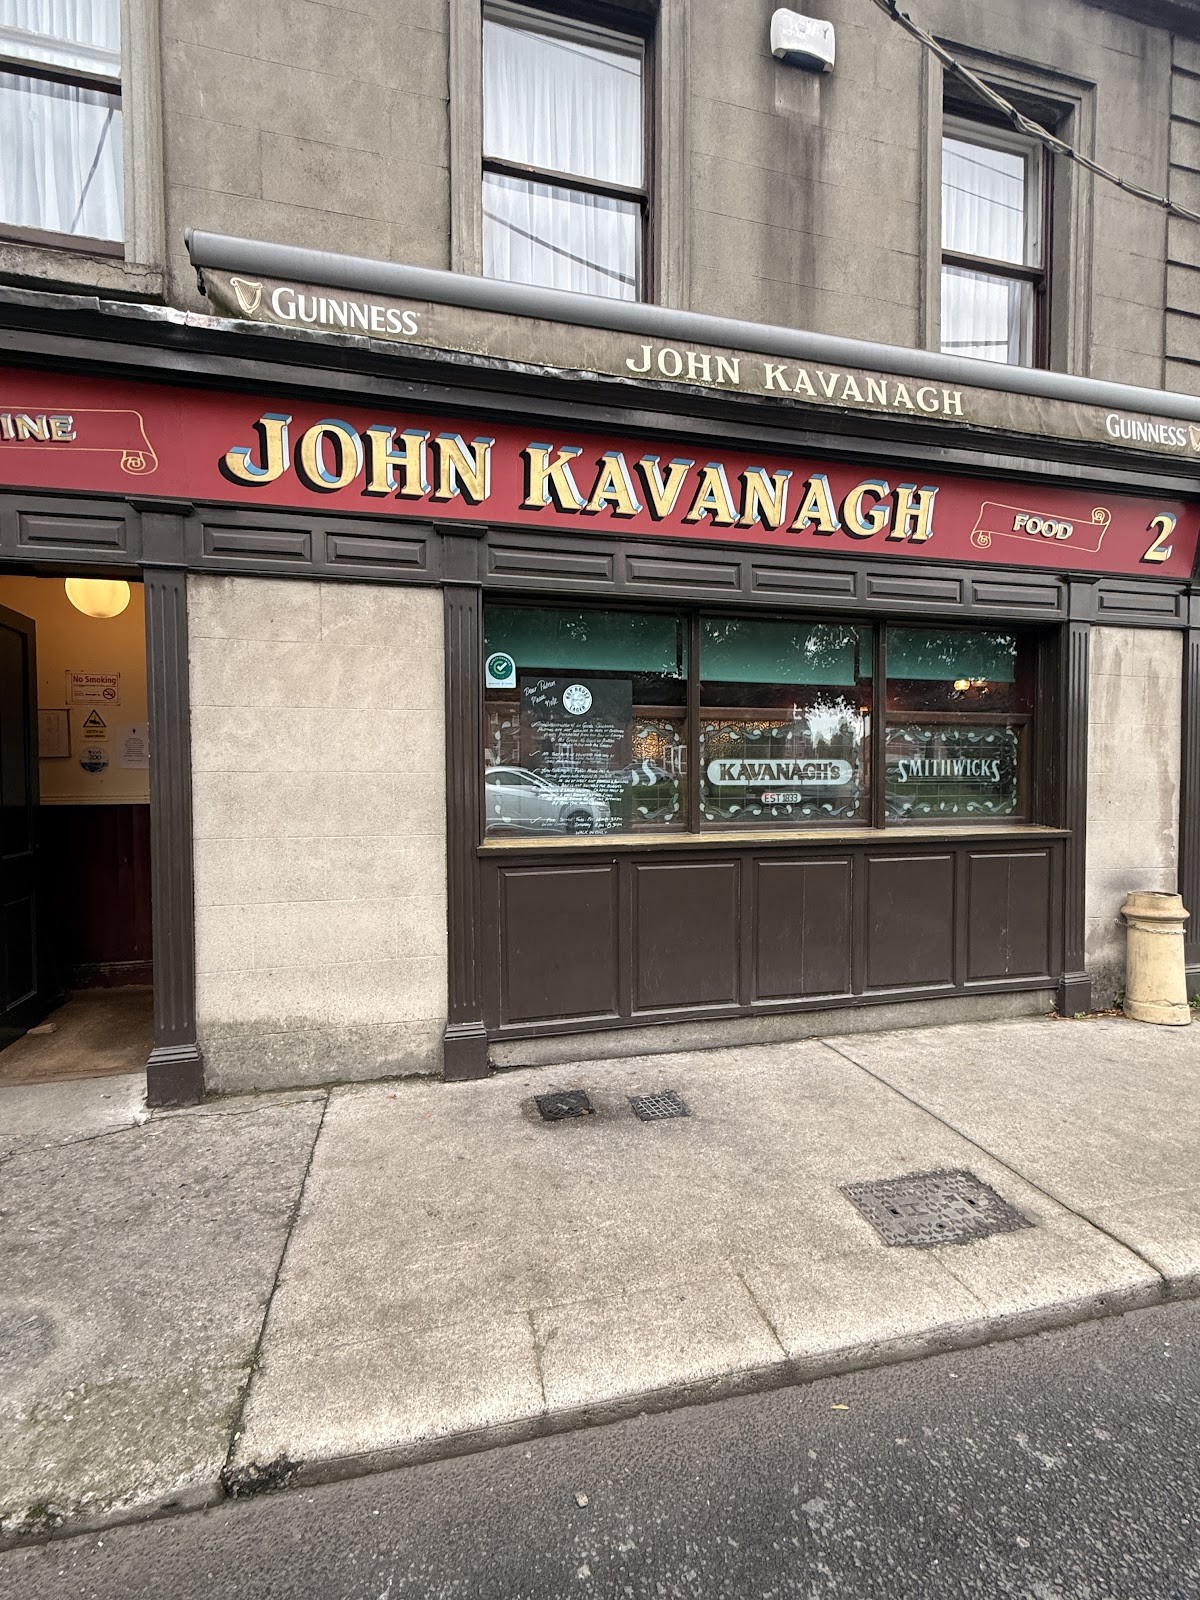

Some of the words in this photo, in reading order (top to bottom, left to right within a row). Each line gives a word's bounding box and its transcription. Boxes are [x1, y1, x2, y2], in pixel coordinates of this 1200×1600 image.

[271, 286, 418, 337] GUINNESS
[626, 344, 741, 386] JOHN
[764, 363, 964, 417] KAVANAGH
[1106, 413, 1187, 447] GUINNESS
[221, 412, 496, 504] JOHN
[521, 441, 939, 544] KAVANAGH
[1012, 513, 1074, 540] FOOD
[1139, 511, 1177, 564] 2
[73, 675, 84, 683] No
[85, 675, 116, 685] Smoking
[898, 759, 1001, 783] SMITHWICKS
[764, 793, 781, 803] EST
[782, 793, 799, 803] 1833
